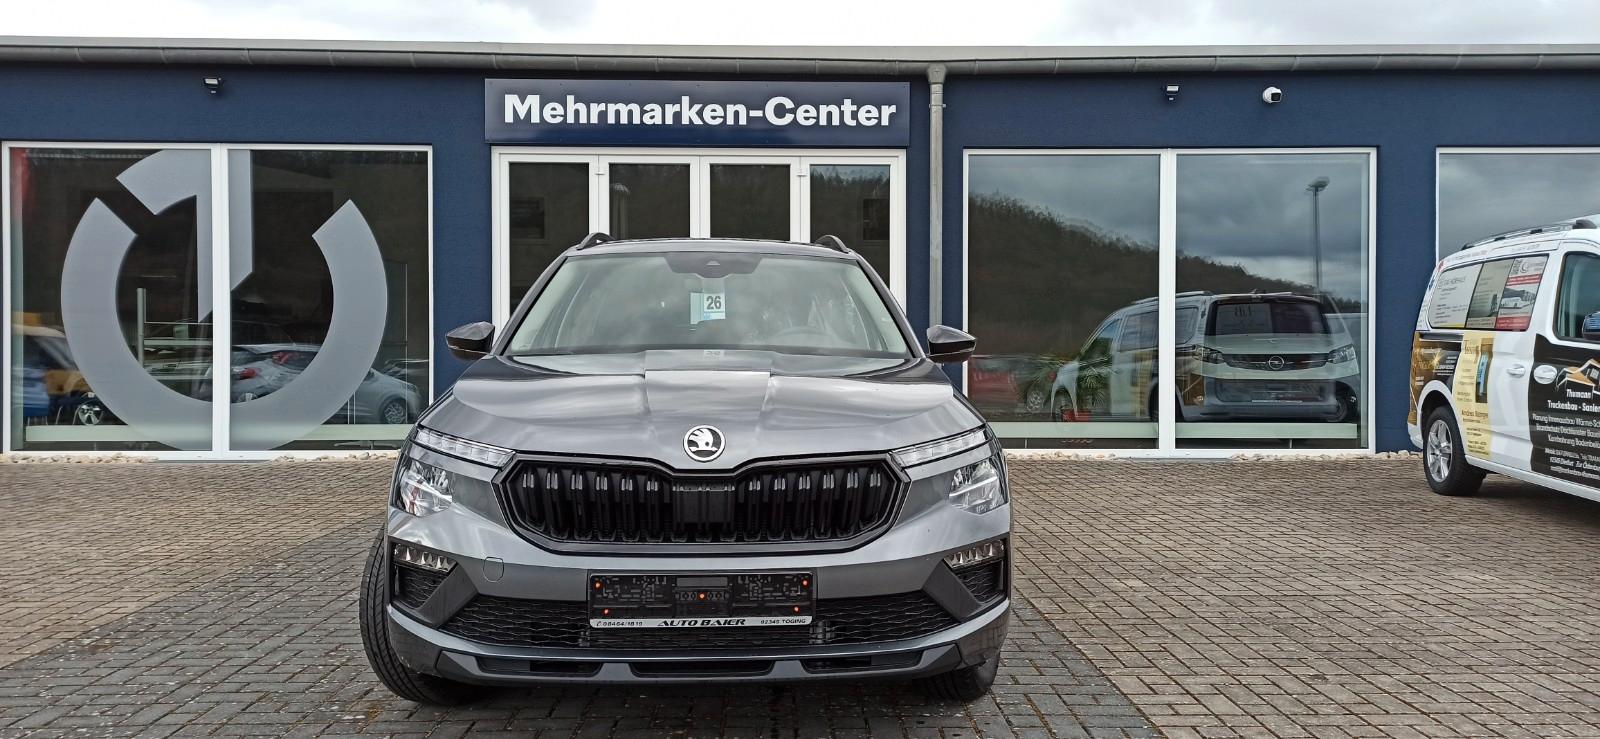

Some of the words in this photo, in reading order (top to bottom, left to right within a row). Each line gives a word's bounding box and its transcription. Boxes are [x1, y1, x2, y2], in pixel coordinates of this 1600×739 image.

[504, 93, 897, 127] Mehrmarken-Center
[706, 295, 722, 310] 26
[1547, 399, 1578, 411] Trockenbau
[657, 619, 698, 627] AUTO
[700, 618, 746, 626] BAIER
